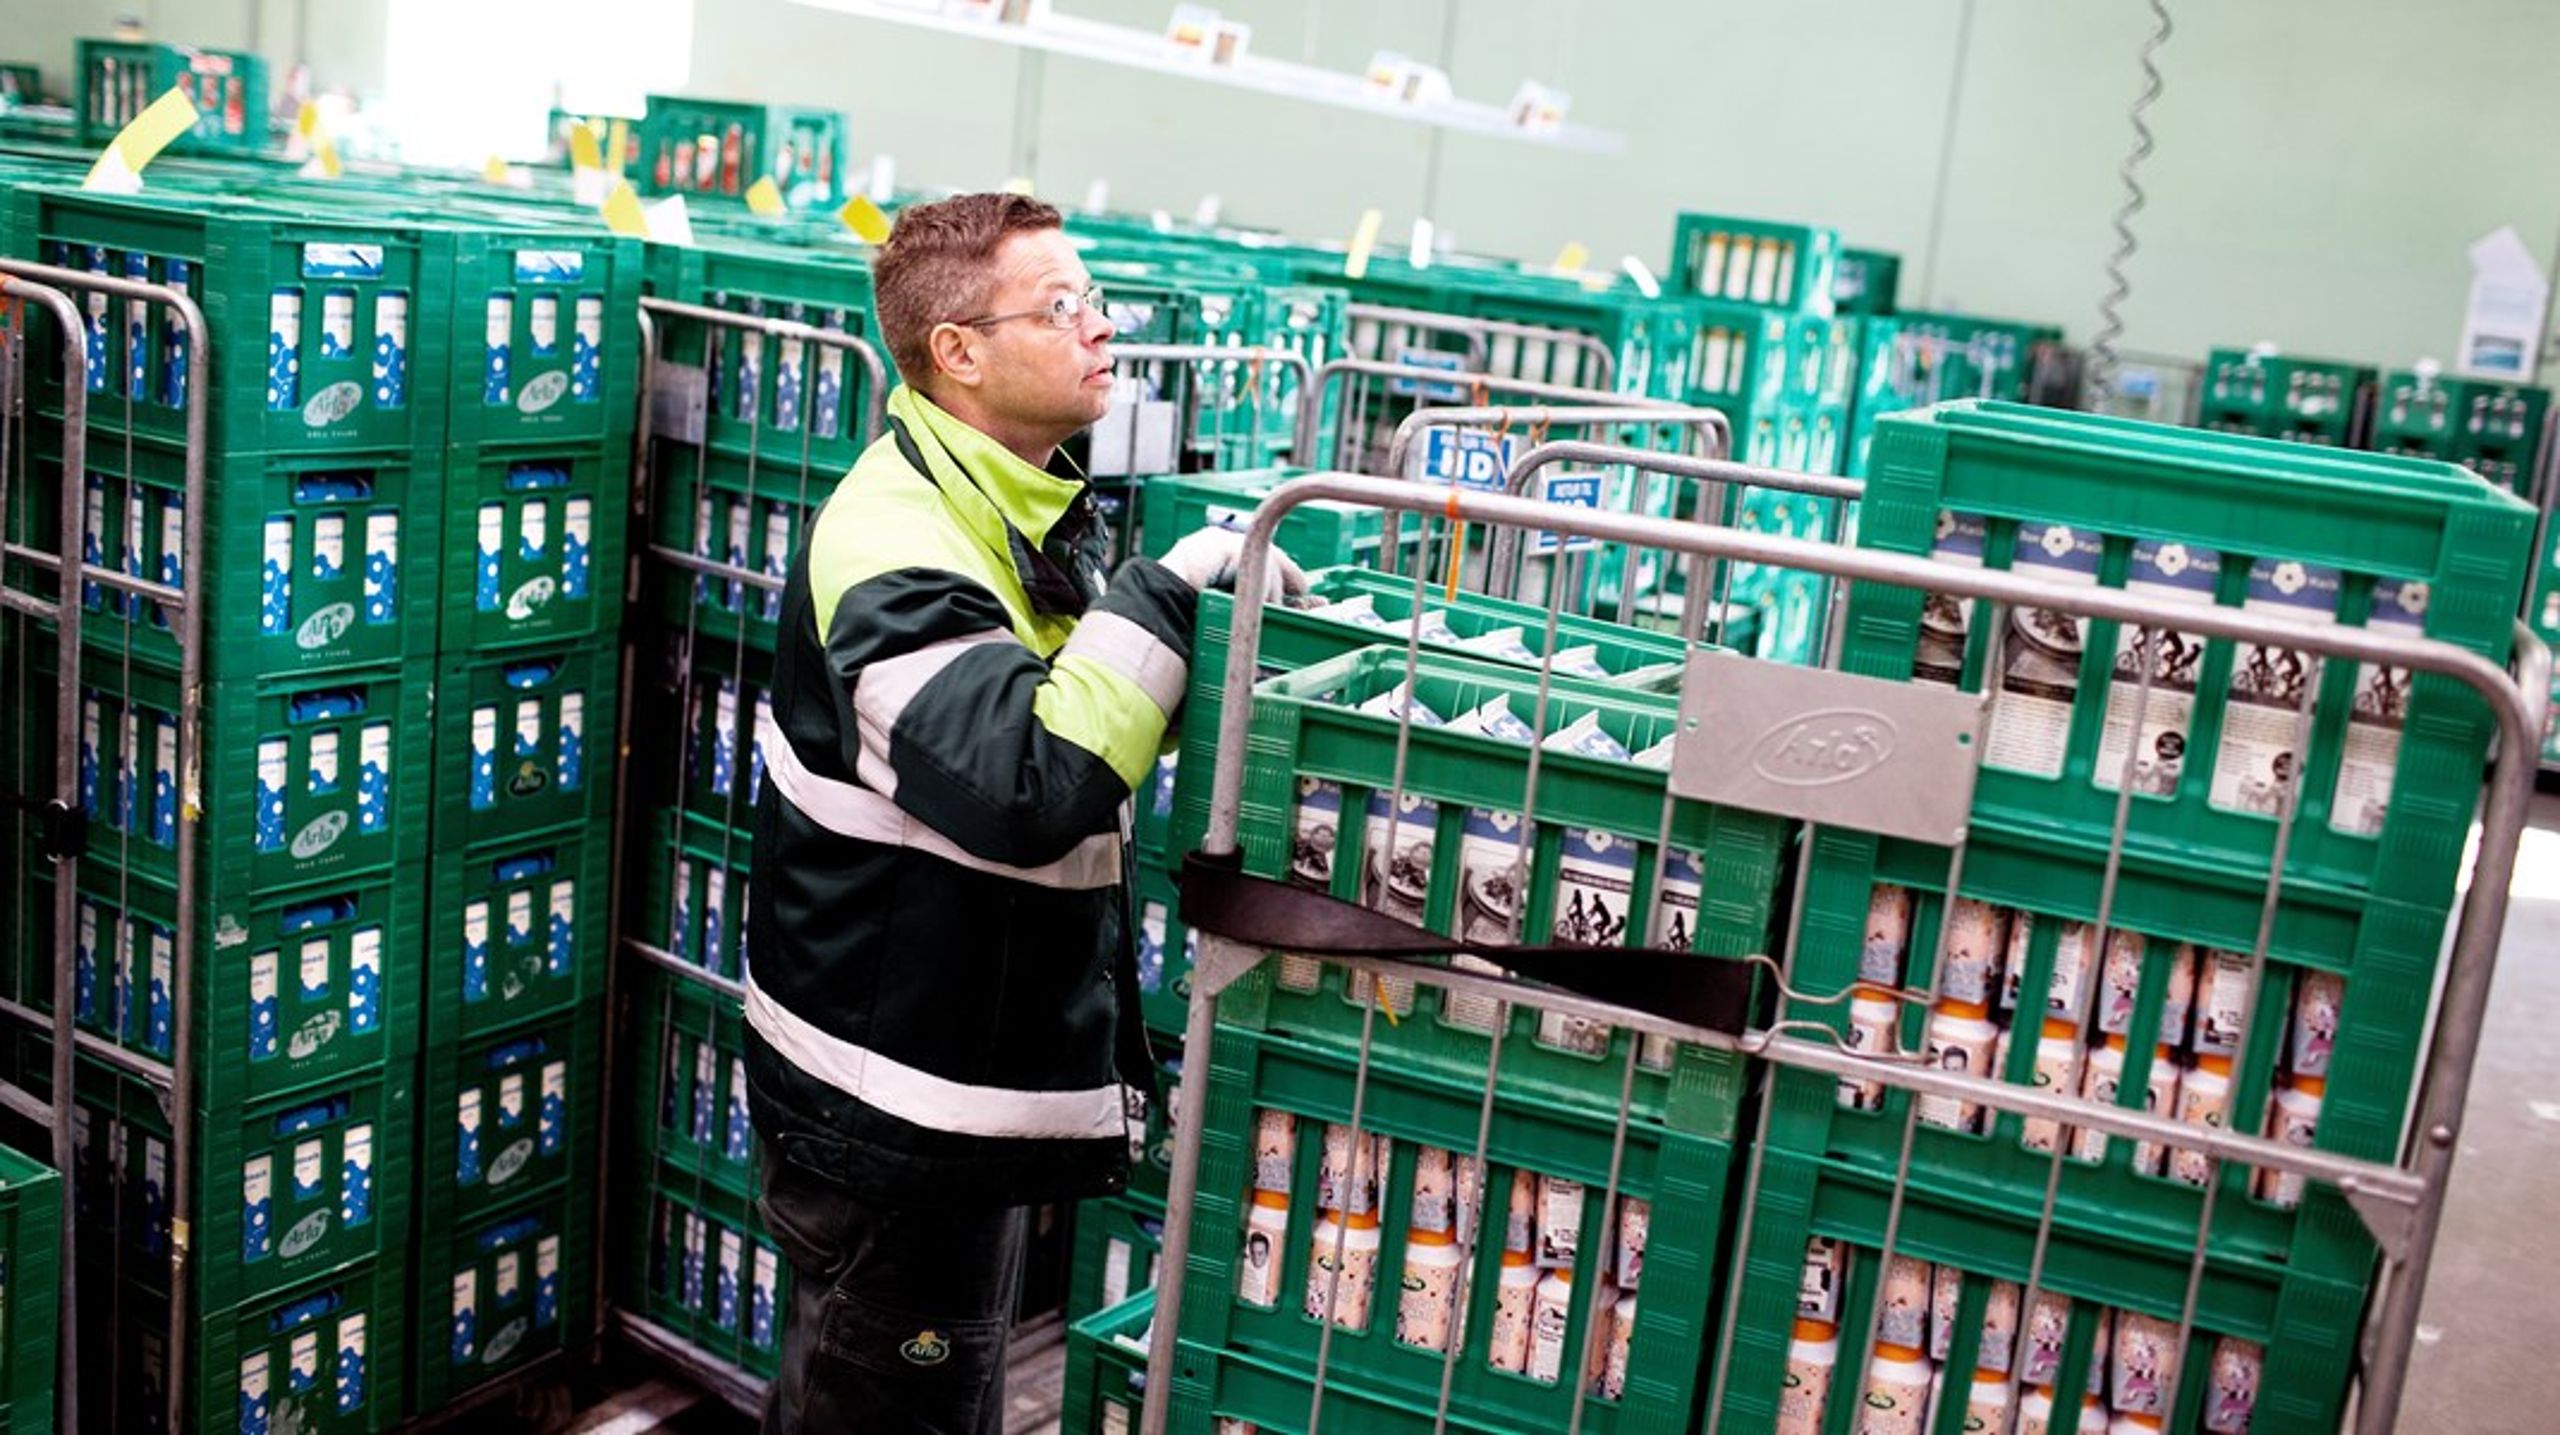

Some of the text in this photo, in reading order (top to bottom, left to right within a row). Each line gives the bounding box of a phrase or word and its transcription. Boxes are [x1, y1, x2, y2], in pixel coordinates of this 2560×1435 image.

[1774, 723, 1859, 768] Arla
[299, 824, 334, 847] Arla
[286, 1223, 321, 1247] Arla
[909, 1342, 941, 1357] Arla
